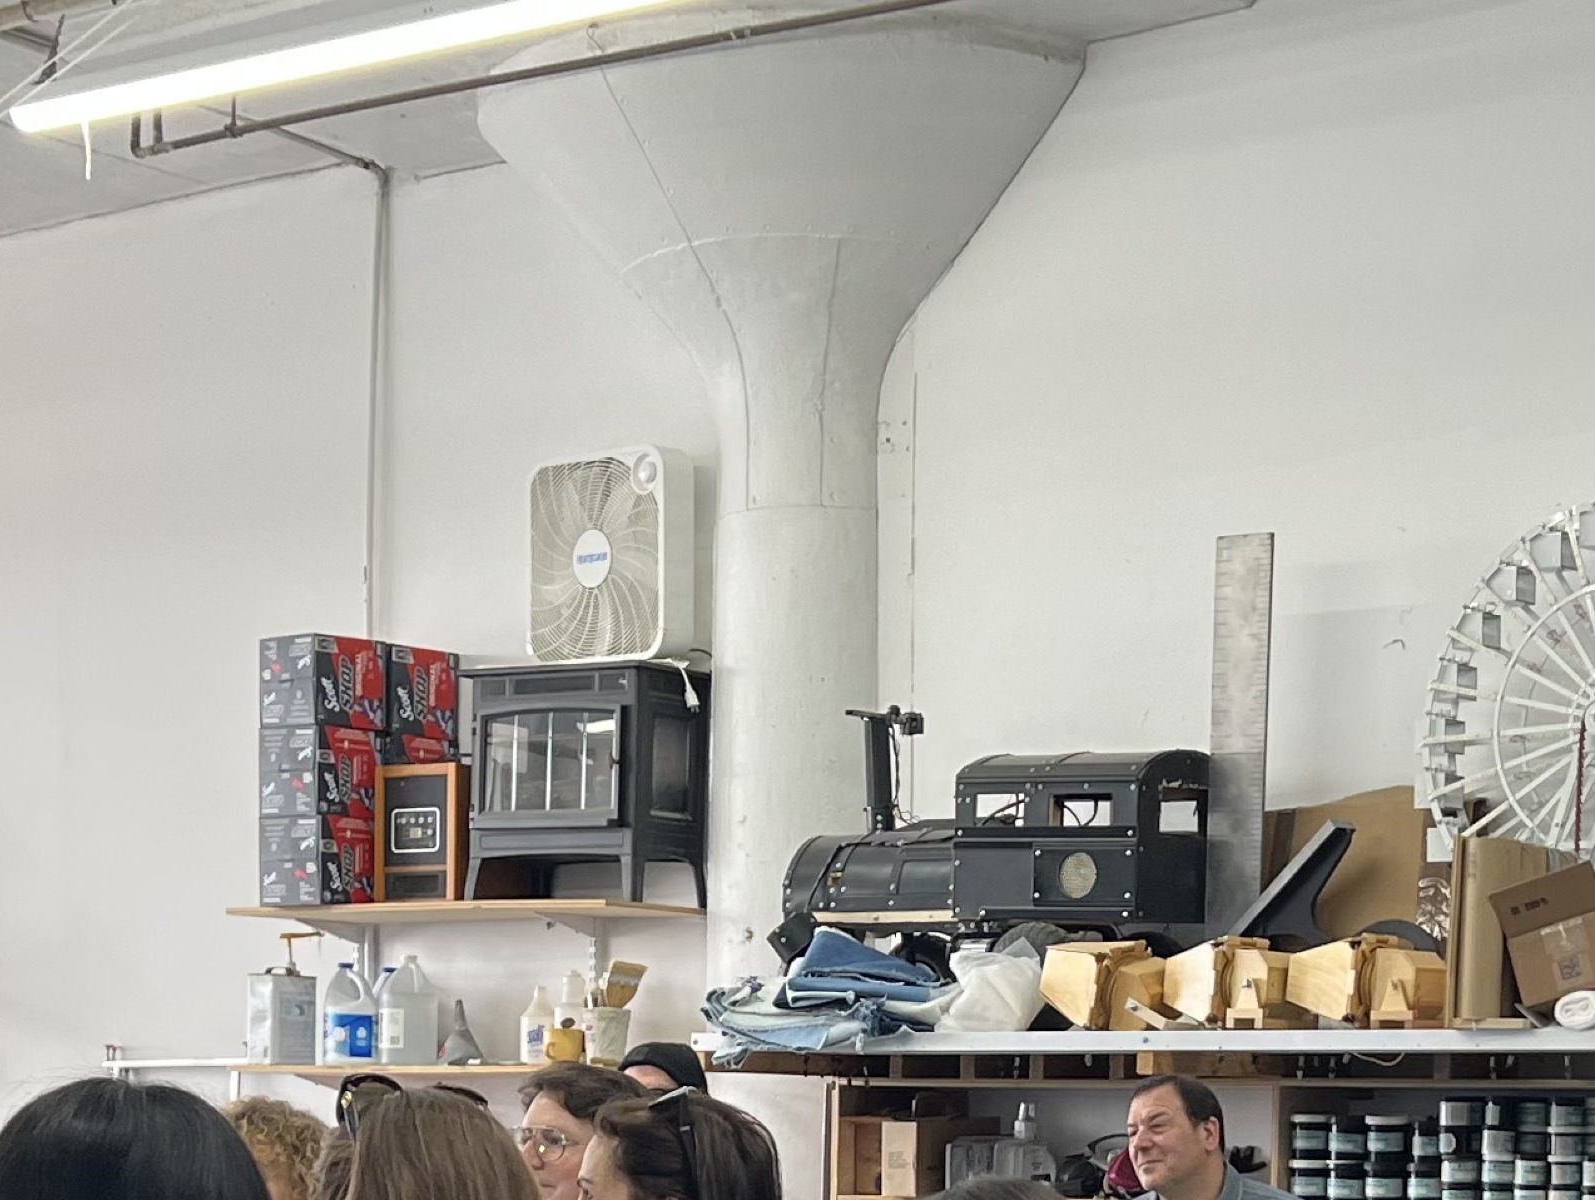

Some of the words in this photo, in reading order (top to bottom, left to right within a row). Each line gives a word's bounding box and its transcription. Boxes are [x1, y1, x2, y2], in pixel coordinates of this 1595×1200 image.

[320, 676, 341, 713] Scott
[337, 654, 355, 713] SHOP
[396, 685, 416, 721] Scott
[413, 665, 430, 722] SHOP
[324, 771, 341, 803] Scott
[337, 752, 353, 803] SHOP
[327, 860, 344, 892] Scott
[340, 842, 356, 896] SHOP
